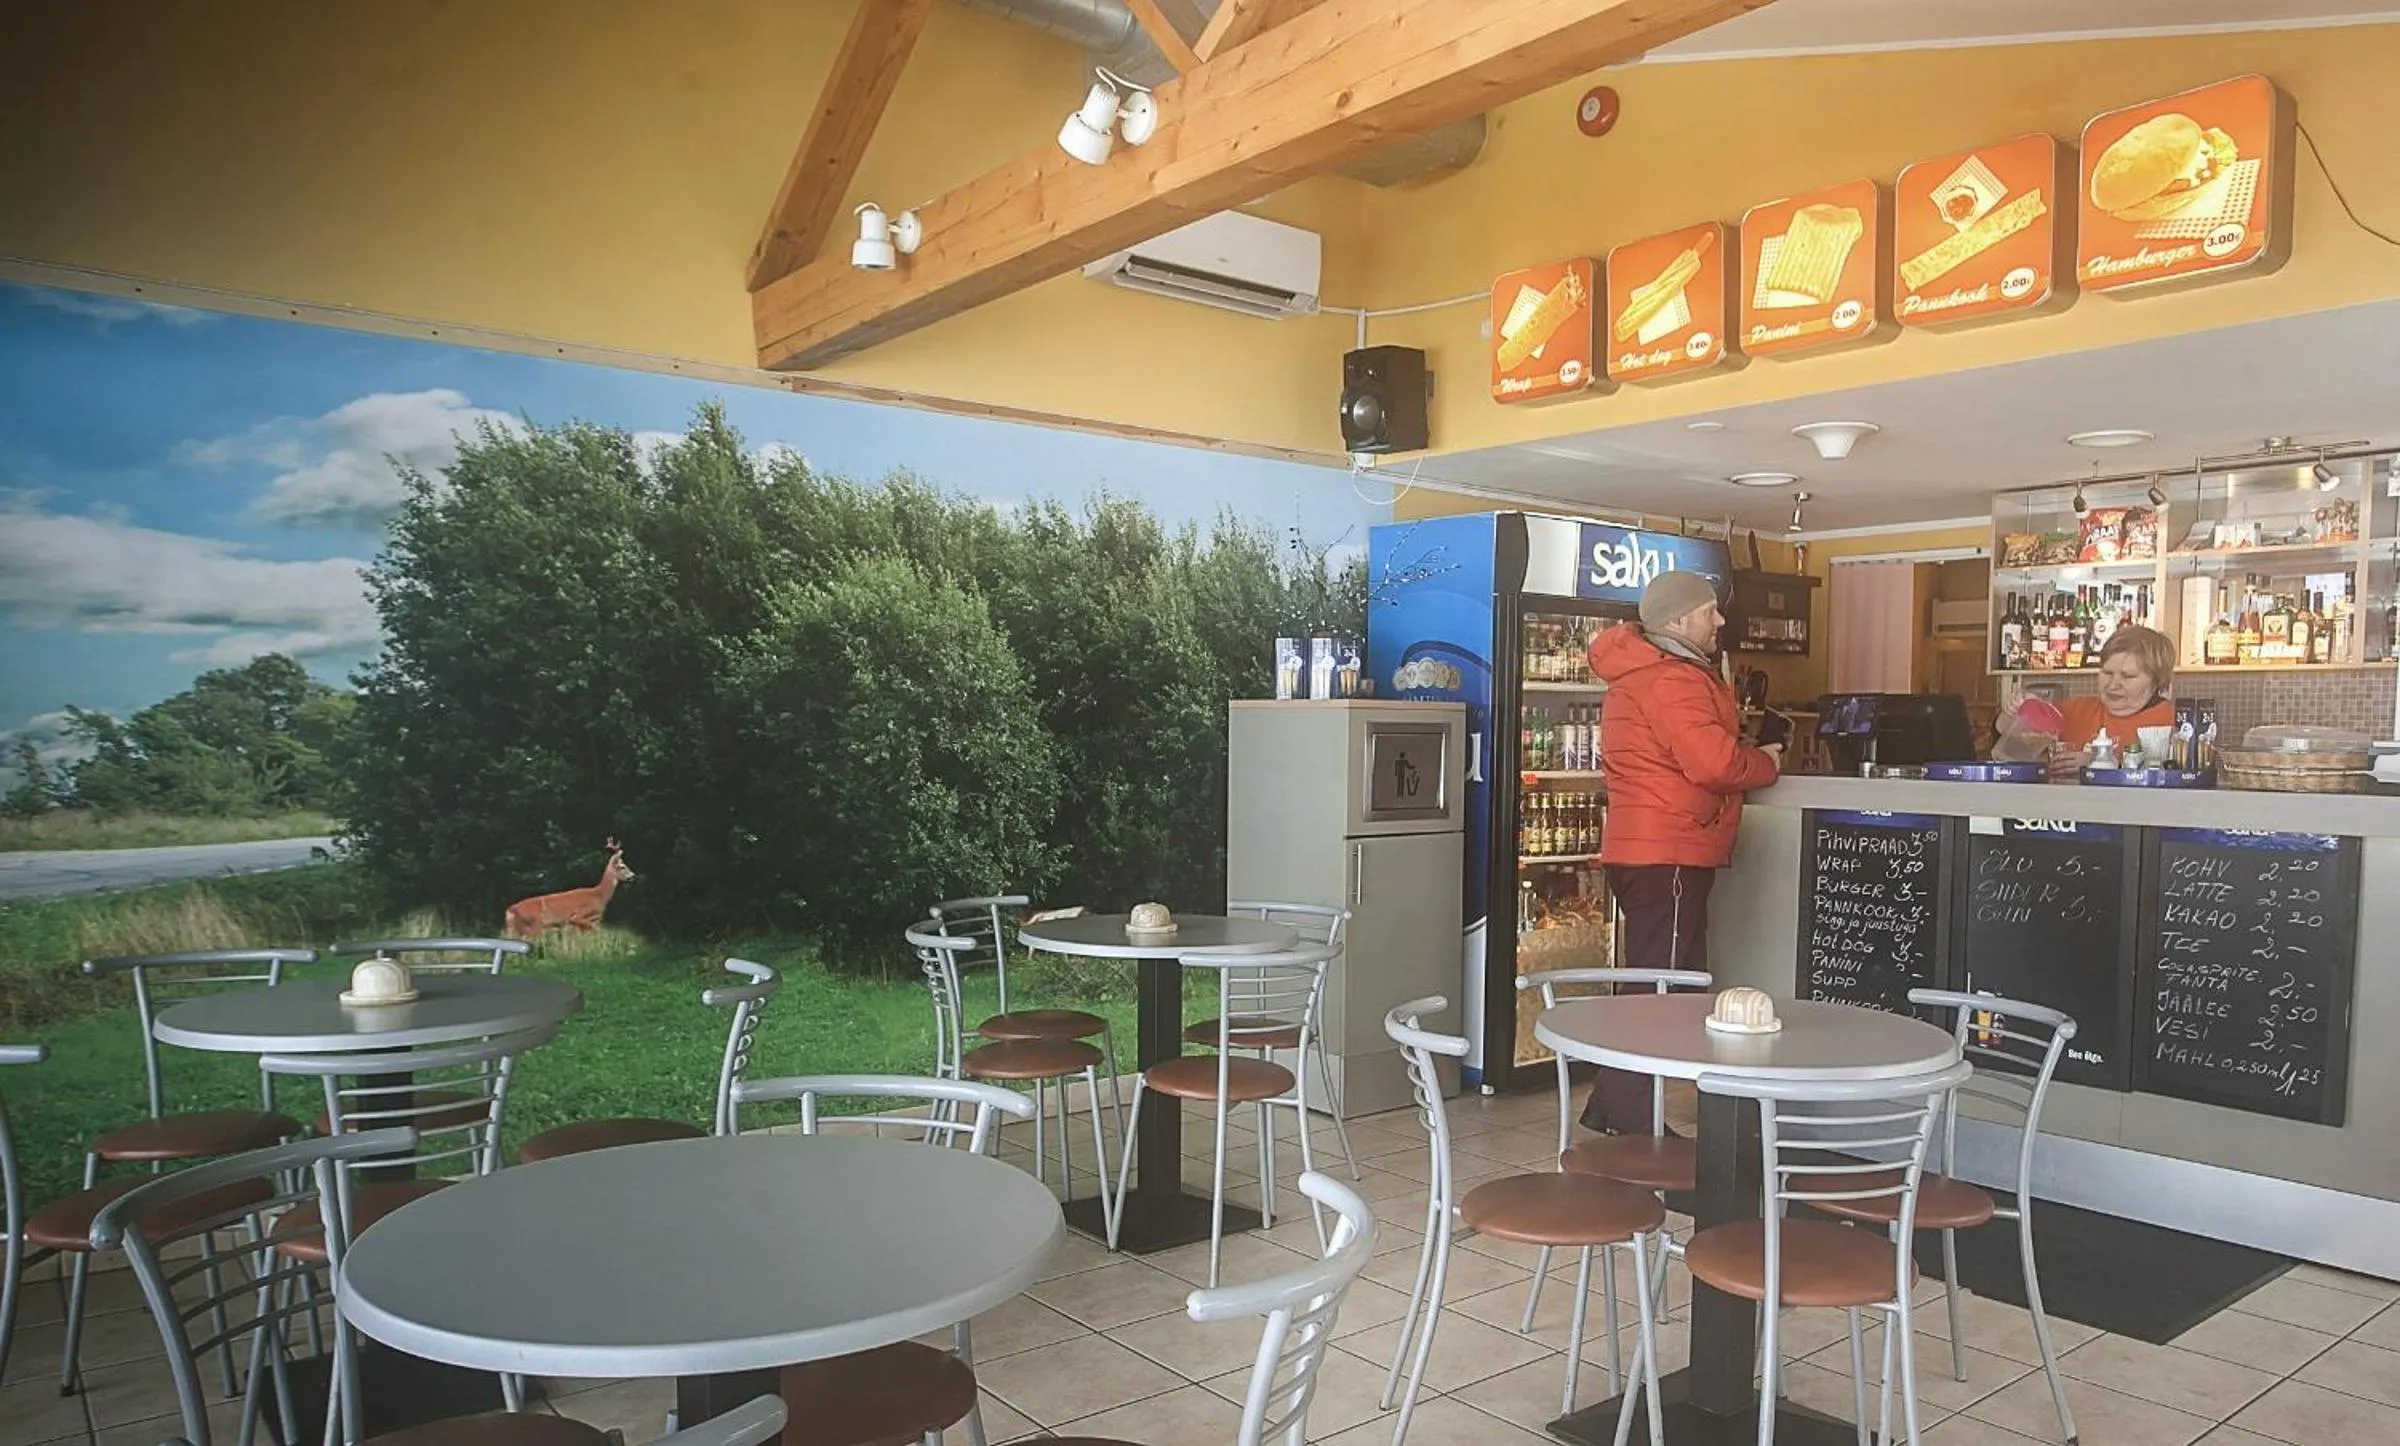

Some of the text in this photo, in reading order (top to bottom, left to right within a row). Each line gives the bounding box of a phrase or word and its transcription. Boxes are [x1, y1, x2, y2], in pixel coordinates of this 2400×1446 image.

[2087, 244, 2197, 277] Hamburger
[1751, 322, 1801, 342] Panini
[1620, 347, 1673, 371] Hot dog
[1591, 531, 1675, 588] saku
[1816, 854, 1862, 873] WRAP
[2169, 856, 2232, 878] KOHV
[1815, 875, 1885, 898] BURGER
[2164, 880, 2235, 903] LATTE
[1813, 894, 1898, 920] PANNKOOK
[2163, 903, 2237, 930] KAKAO
[1840, 939, 1875, 953] DOG
[2161, 931, 2211, 953] TEE
[1811, 970, 1857, 988] SUPP
[2156, 1042, 2215, 1068] MAHL
